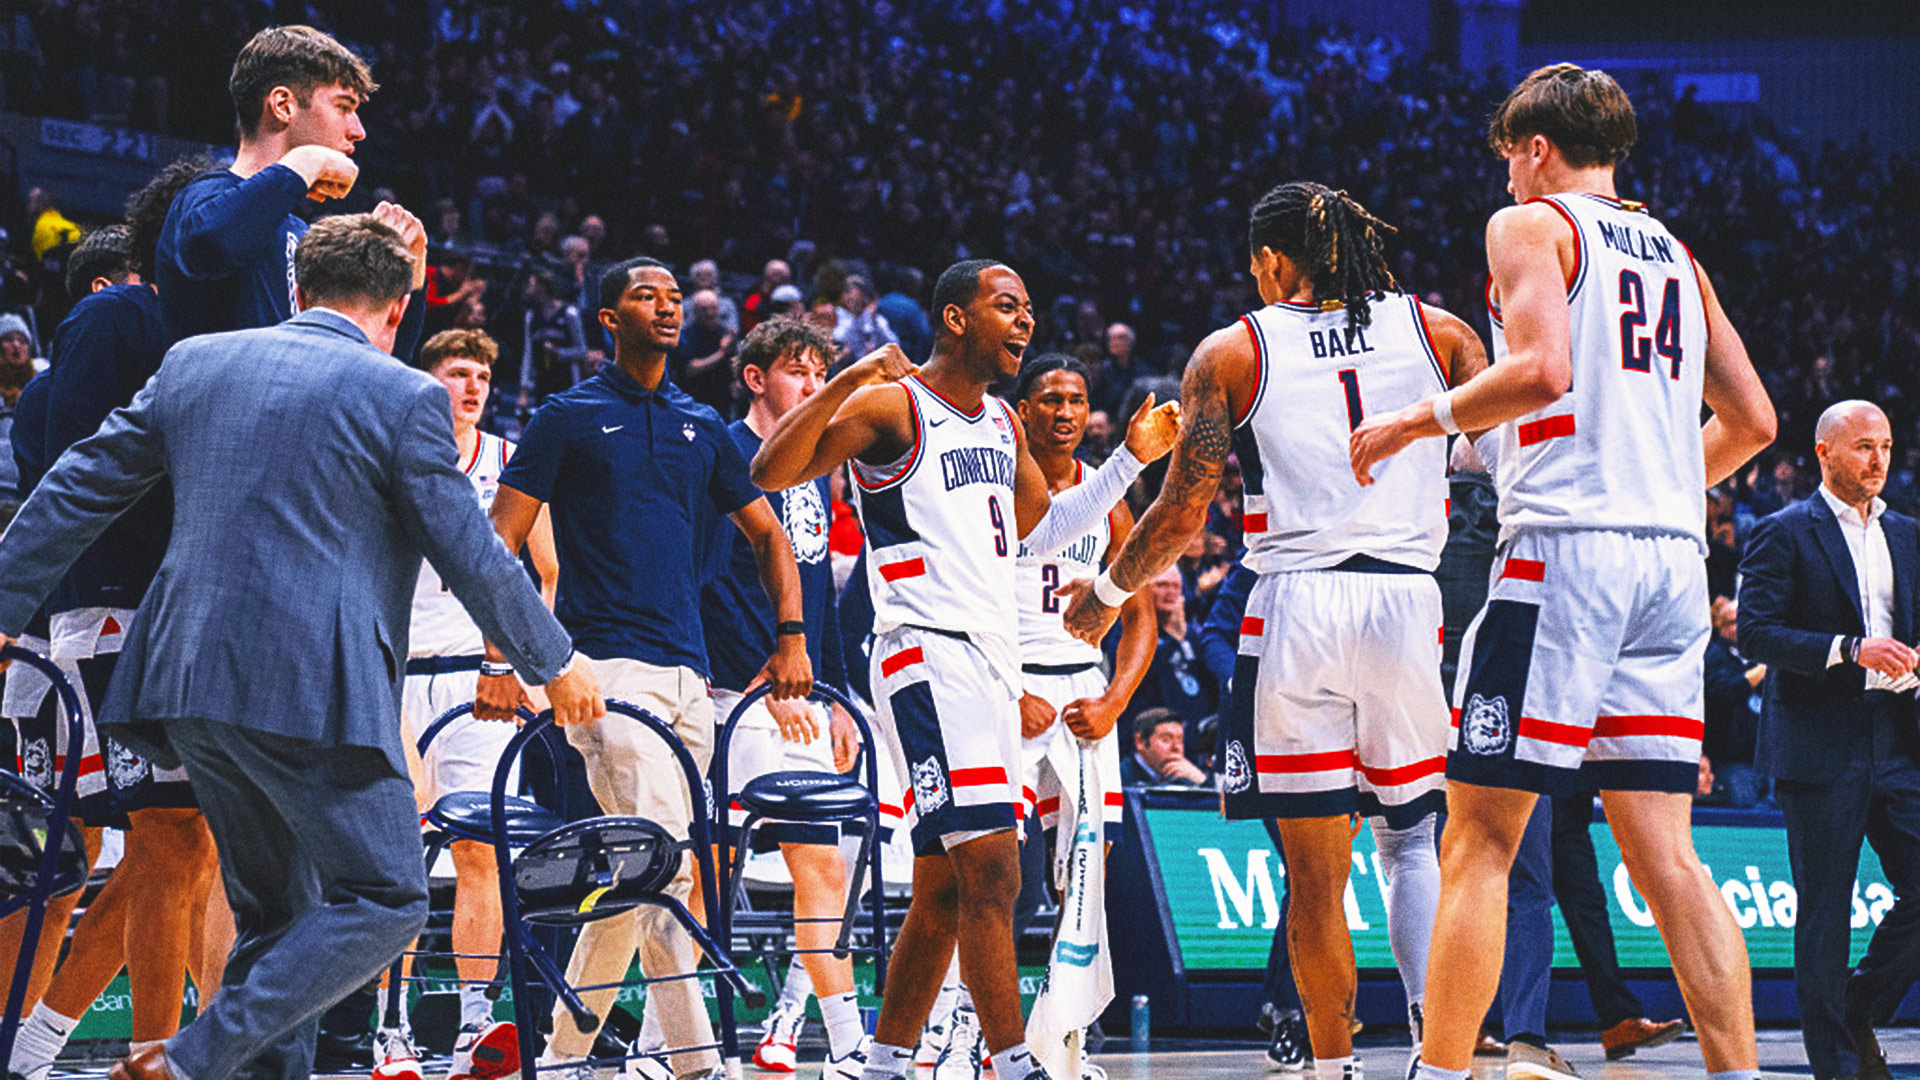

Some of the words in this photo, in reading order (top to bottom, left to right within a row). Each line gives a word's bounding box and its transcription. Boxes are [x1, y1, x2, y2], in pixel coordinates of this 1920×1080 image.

[1597, 218, 1675, 263] MULLIN
[1309, 326, 1375, 359] BALL
[1619, 268, 1683, 380] 24
[1338, 368, 1364, 433] 1
[988, 495, 1008, 558] 9
[1042, 564, 1060, 614] 2
[1197, 848, 1369, 930] MT
[92, 992, 133, 1011] Ban
